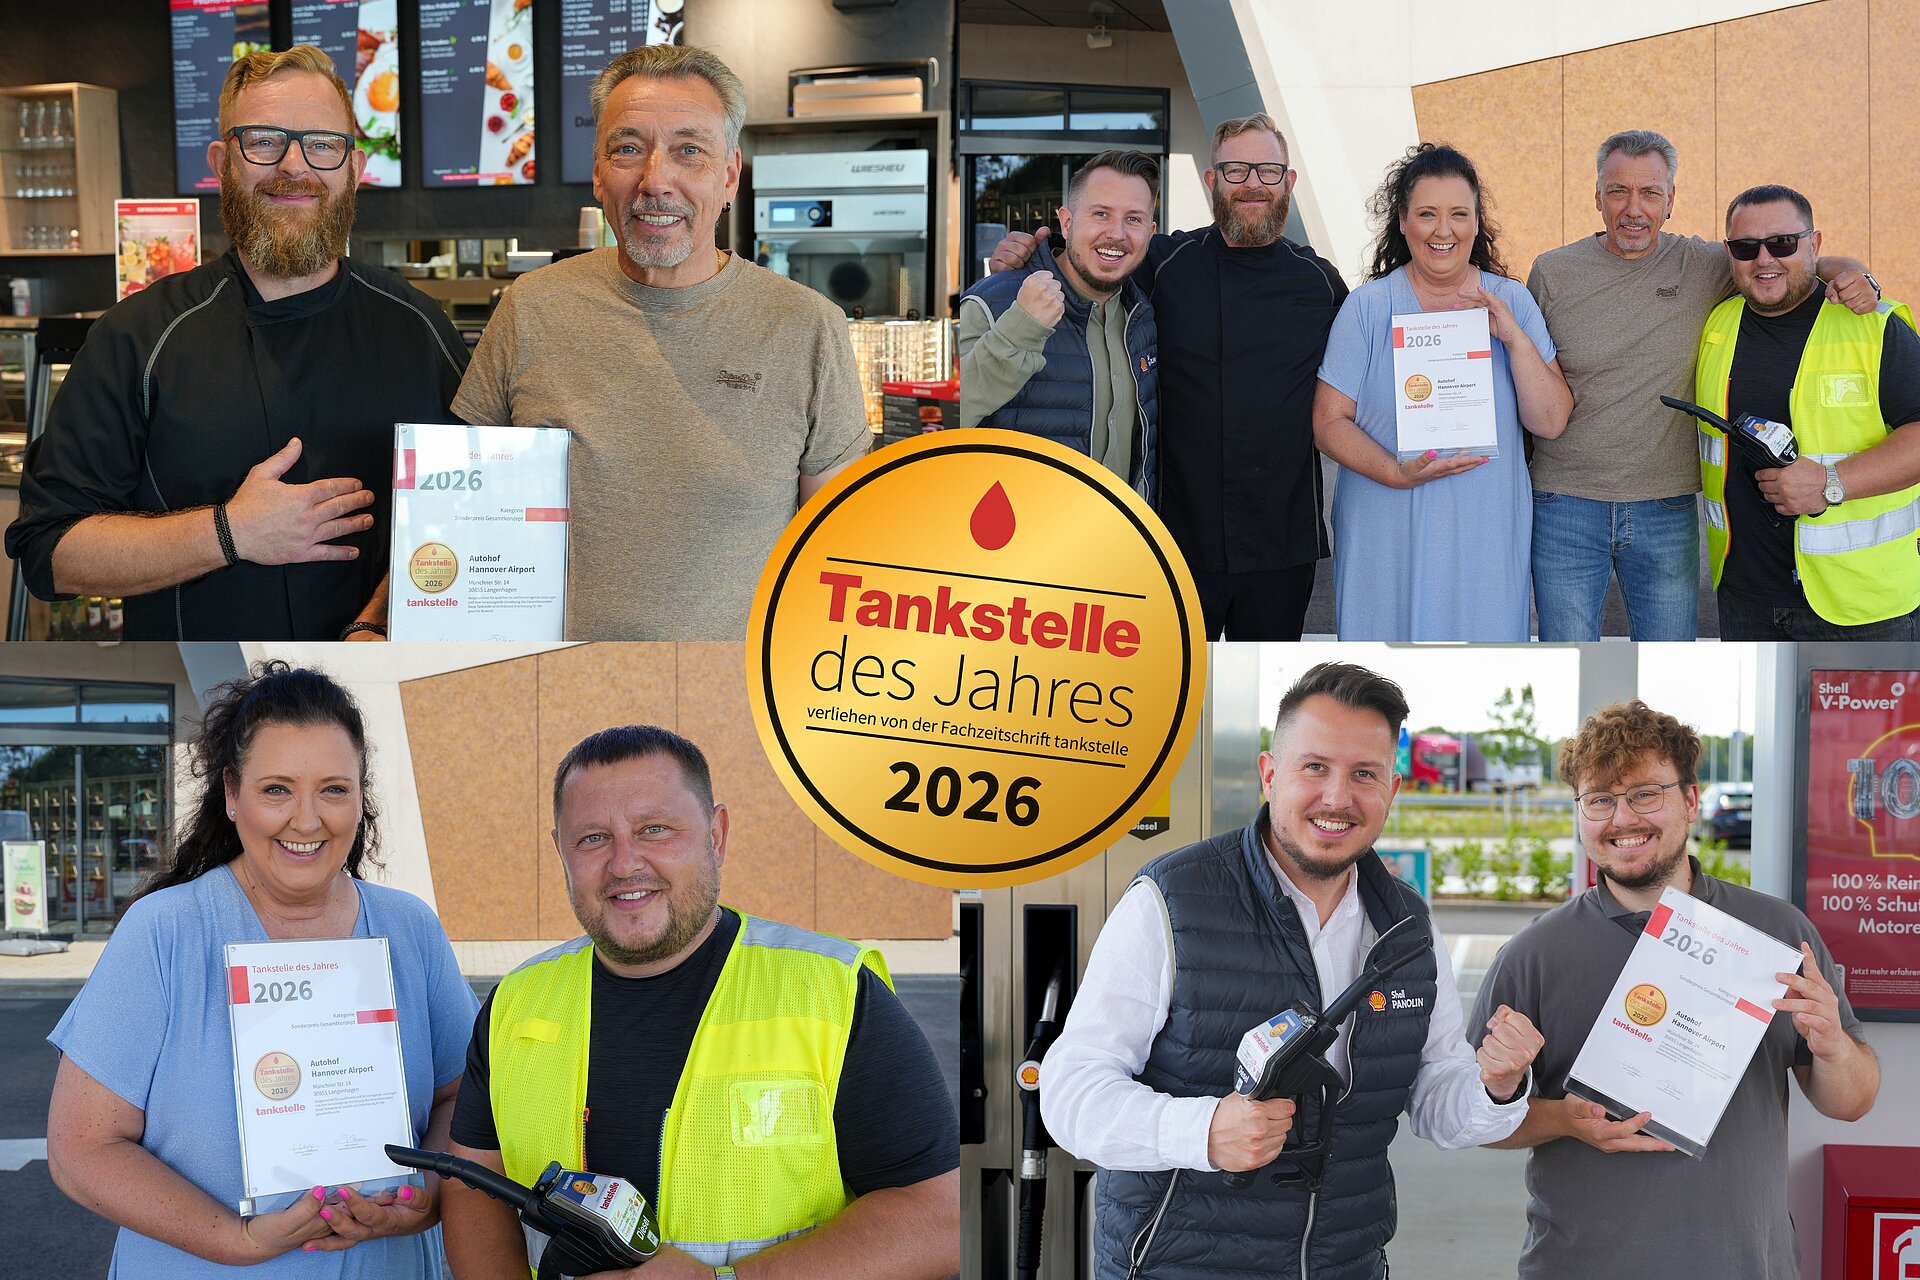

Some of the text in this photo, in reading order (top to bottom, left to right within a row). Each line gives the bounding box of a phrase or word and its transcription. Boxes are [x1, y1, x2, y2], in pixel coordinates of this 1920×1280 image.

[1406, 334, 1441, 348] 2026
[420, 469, 483, 491] 2026
[416, 559, 452, 567] Tankstelle
[469, 554, 501, 562] Autohof
[508, 565, 536, 574] Airport
[407, 598, 459, 607] tankstelle
[1819, 682, 1849, 694] Shell
[1819, 695, 1899, 710] V-Power
[1831, 873, 1863, 889] 100
[1866, 874, 1882, 890] %
[1822, 895, 1920, 912] 100 % Schu
[1676, 912, 1750, 956] Tankstelle des Jahres
[1663, 928, 1718, 965] 2026
[252, 962, 339, 974] Tankstelle des Jahres
[1850, 968, 1869, 976] Jetzt
[1870, 968, 1889, 976] mehr
[253, 980, 313, 1003] 2026
[1391, 989, 1406, 999] Shell
[1391, 997, 1424, 1009] PANOLIN
[1633, 1011, 1648, 1022] 2026
[1675, 1010, 1703, 1027] Autohof
[1612, 1017, 1653, 1043] tankstelle
[1671, 1018, 1726, 1050] Hannover Airport
[310, 1057, 340, 1067] Autohof
[259, 1067, 295, 1076] Tankstelle
[311, 1065, 374, 1078] Hannover Airport
[271, 1087, 289, 1095] 2026
[256, 1103, 306, 1116] tankstelle
[600, 1181, 620, 1210] tankstelle
[636, 1214, 650, 1241] Diesel
